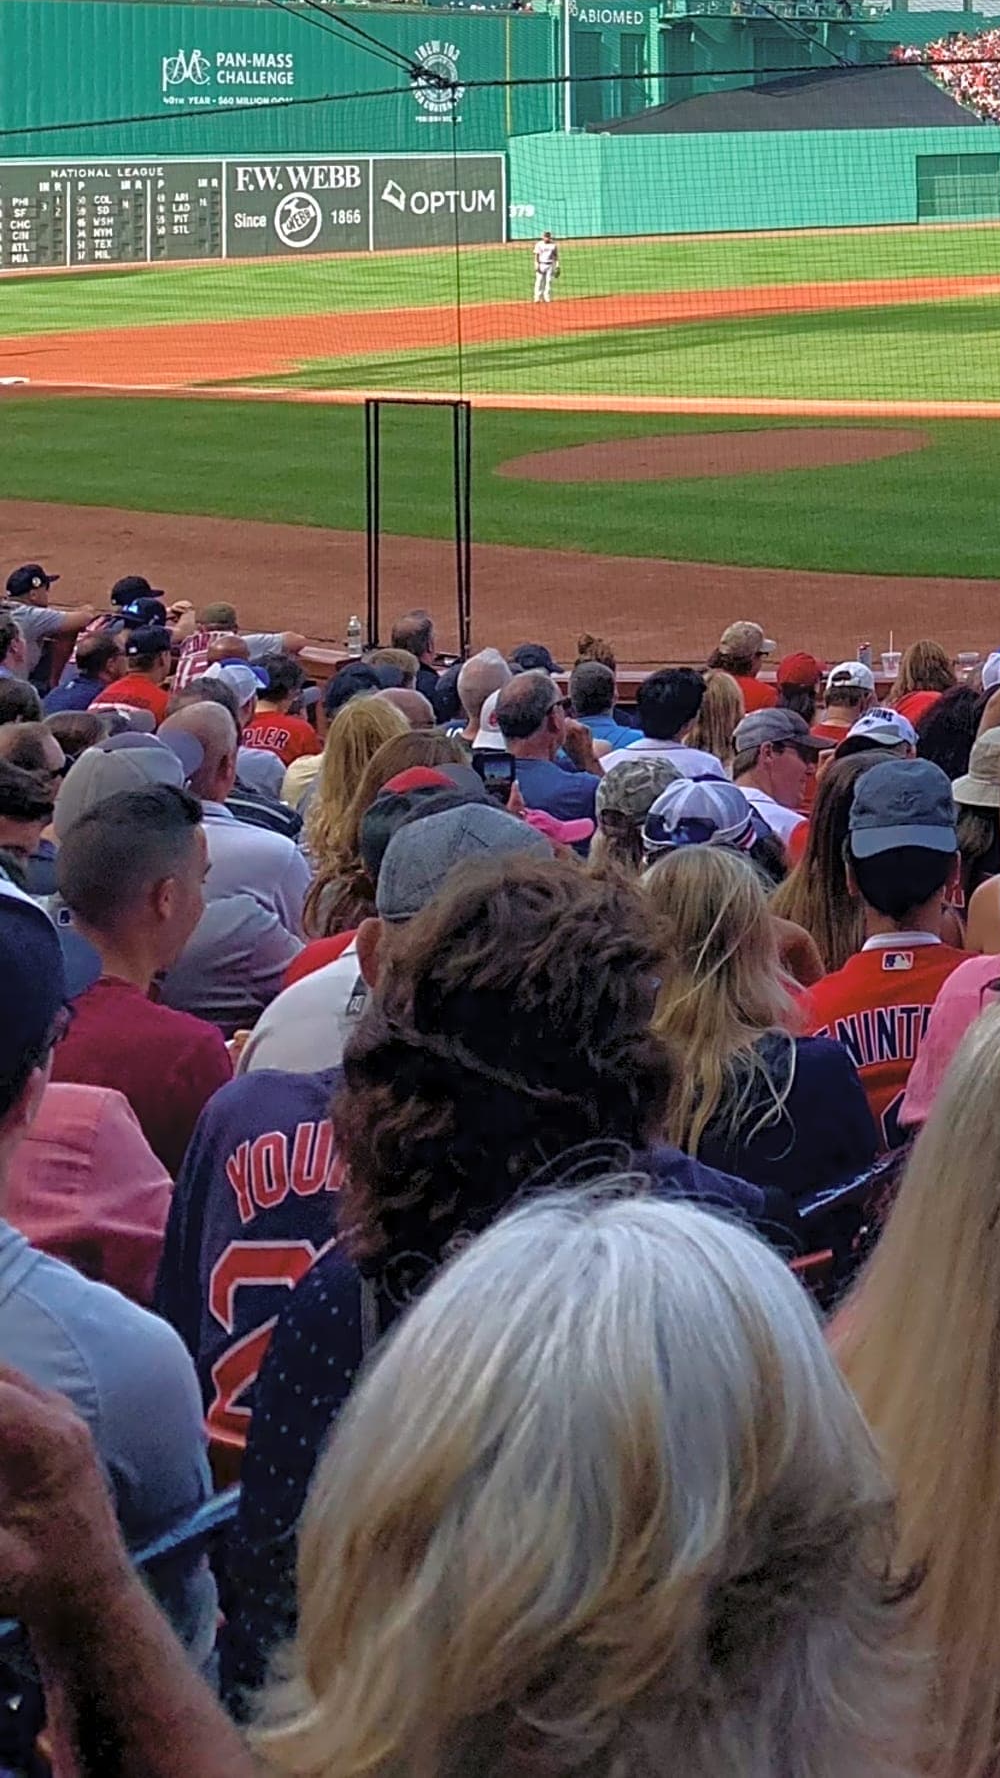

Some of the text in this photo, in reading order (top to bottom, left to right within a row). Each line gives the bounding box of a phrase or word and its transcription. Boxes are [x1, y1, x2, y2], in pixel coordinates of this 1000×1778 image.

[579, 9, 644, 25] ABIOMED
[216, 52, 293, 68] PAN-MASS
[216, 70, 294, 85] CHALLENGE
[188, 96, 211, 105] YEAR
[236, 97, 269, 105] MILLION
[51, 167, 164, 178] NATIONAL LEAGUE
[286, 165, 361, 190] WEBB
[39, 182, 62, 191] IN R
[78, 180, 142, 191] P IN R
[158, 179, 218, 189] P IN R
[12, 197, 29, 207] PHI
[93, 195, 112, 204] COL
[174, 193, 189, 202] ARI
[410, 189, 496, 214] OPTUM
[97, 206, 110, 215] SD
[172, 203, 191, 212] LAD
[14, 208, 27, 218] SF
[93, 217, 114, 226] WSH
[174, 214, 188, 224] PIT
[234, 212, 267, 228] Since
[10, 220, 31, 230] CHC
[172, 225, 190, 234] STL
[12, 231, 29, 241] CIN
[93, 228, 113, 238] NYM
[11, 243, 30, 252] ATL
[94, 239, 112, 249] TEX
[12, 253, 29, 263] MIA
[95, 250, 111, 260] MIL
